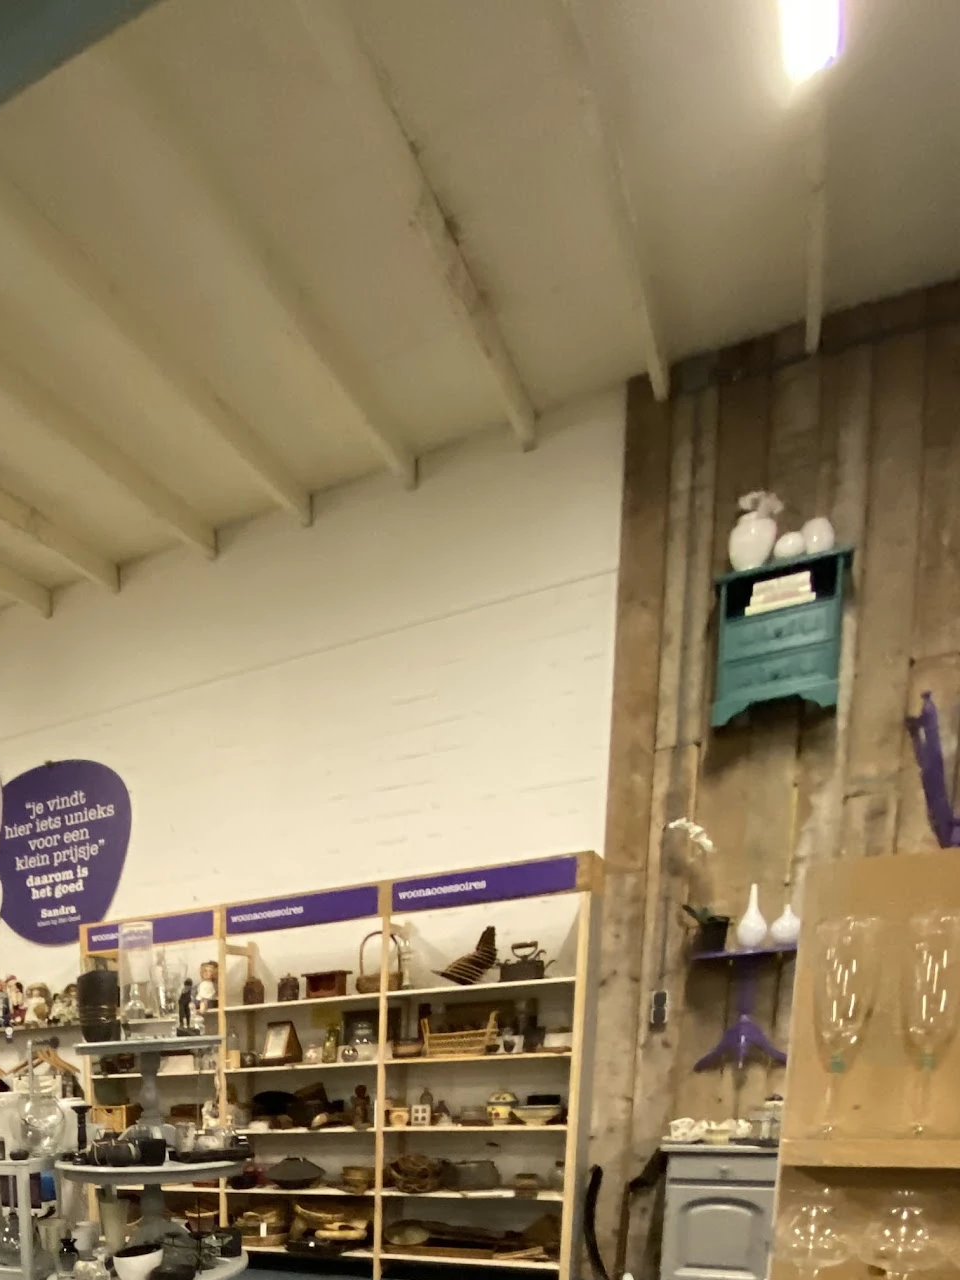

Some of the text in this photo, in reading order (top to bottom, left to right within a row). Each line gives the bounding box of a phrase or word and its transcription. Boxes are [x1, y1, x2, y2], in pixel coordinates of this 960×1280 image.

[47, 790, 86, 812] vindt
[4, 804, 115, 839] hier iets unieks
[28, 828, 89, 851] voor een
[15, 853, 50, 871] klein
[26, 865, 88, 887] daarom is
[31, 879, 84, 900] het goed
[398, 880, 487, 900] woonaccessoires
[41, 905, 76, 918] Sandra
